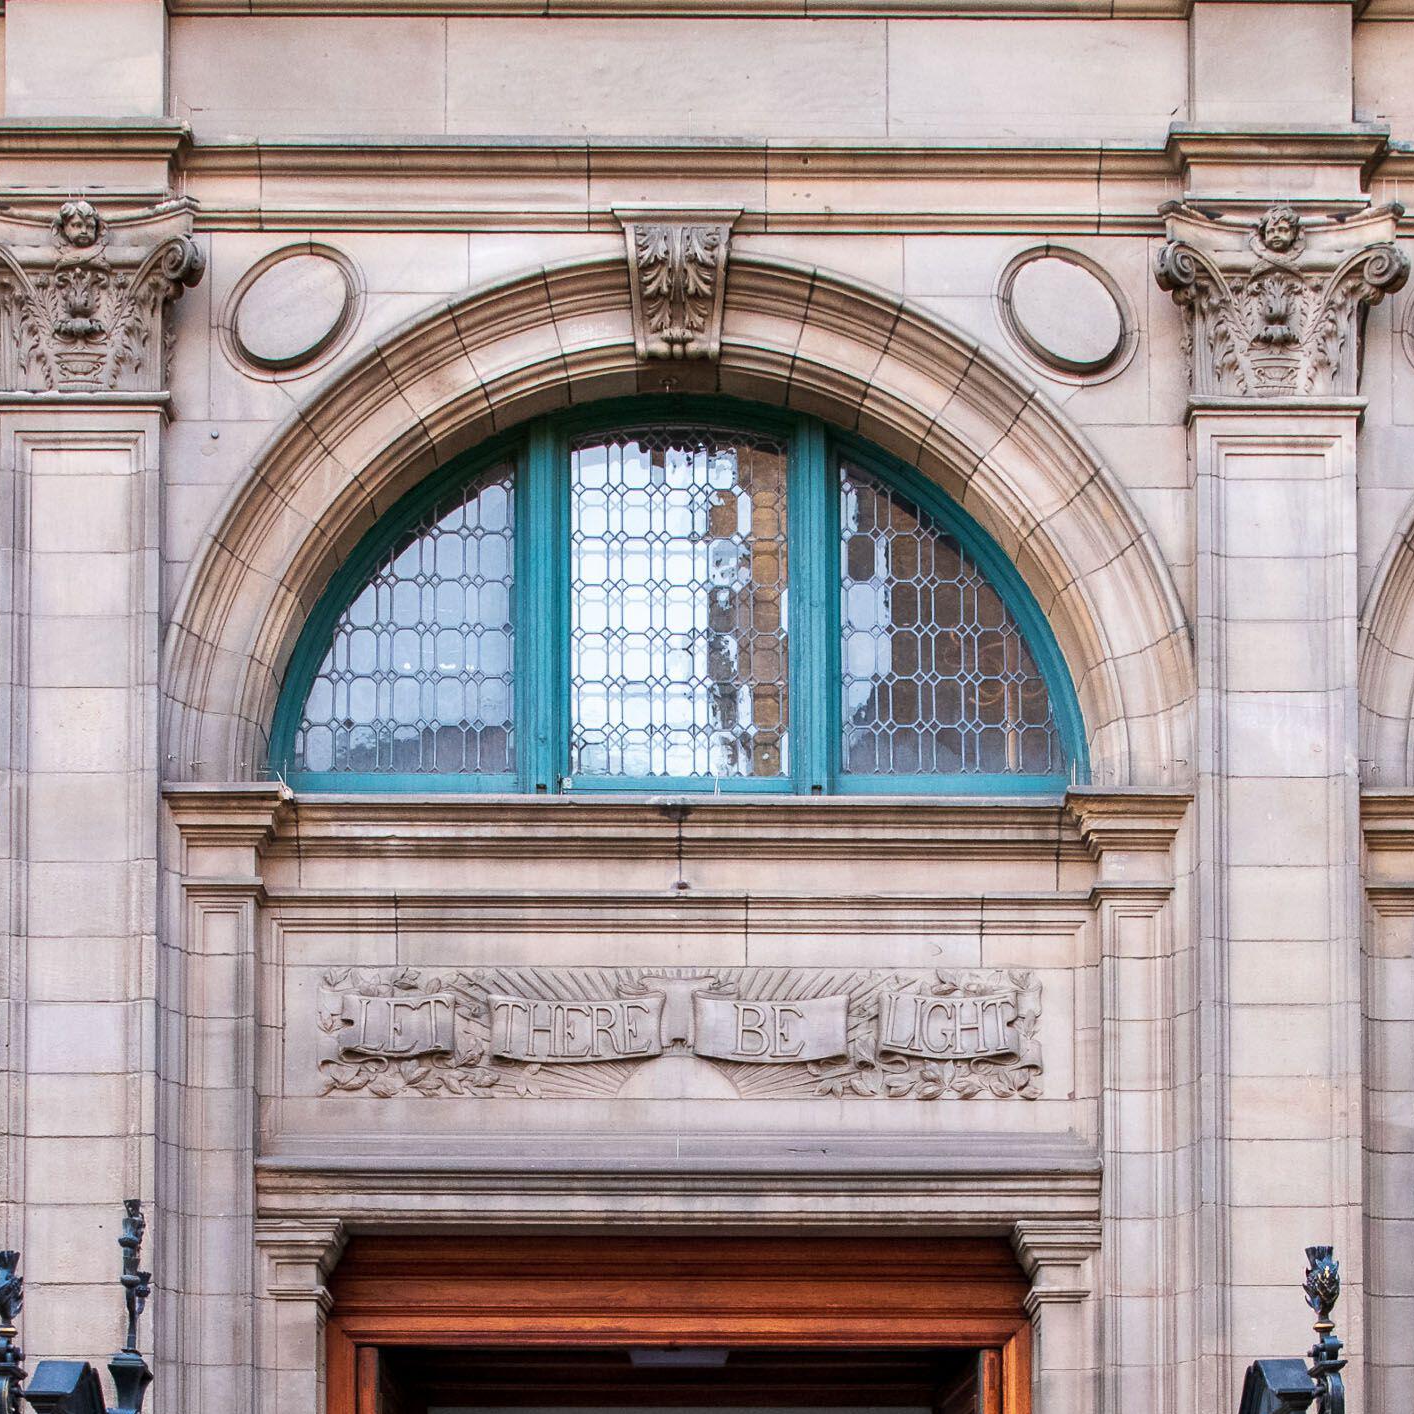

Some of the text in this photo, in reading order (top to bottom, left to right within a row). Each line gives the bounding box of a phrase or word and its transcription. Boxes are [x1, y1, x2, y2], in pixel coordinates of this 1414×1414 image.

[354, 994, 1016, 1057] LET THERE BE LIGHT
